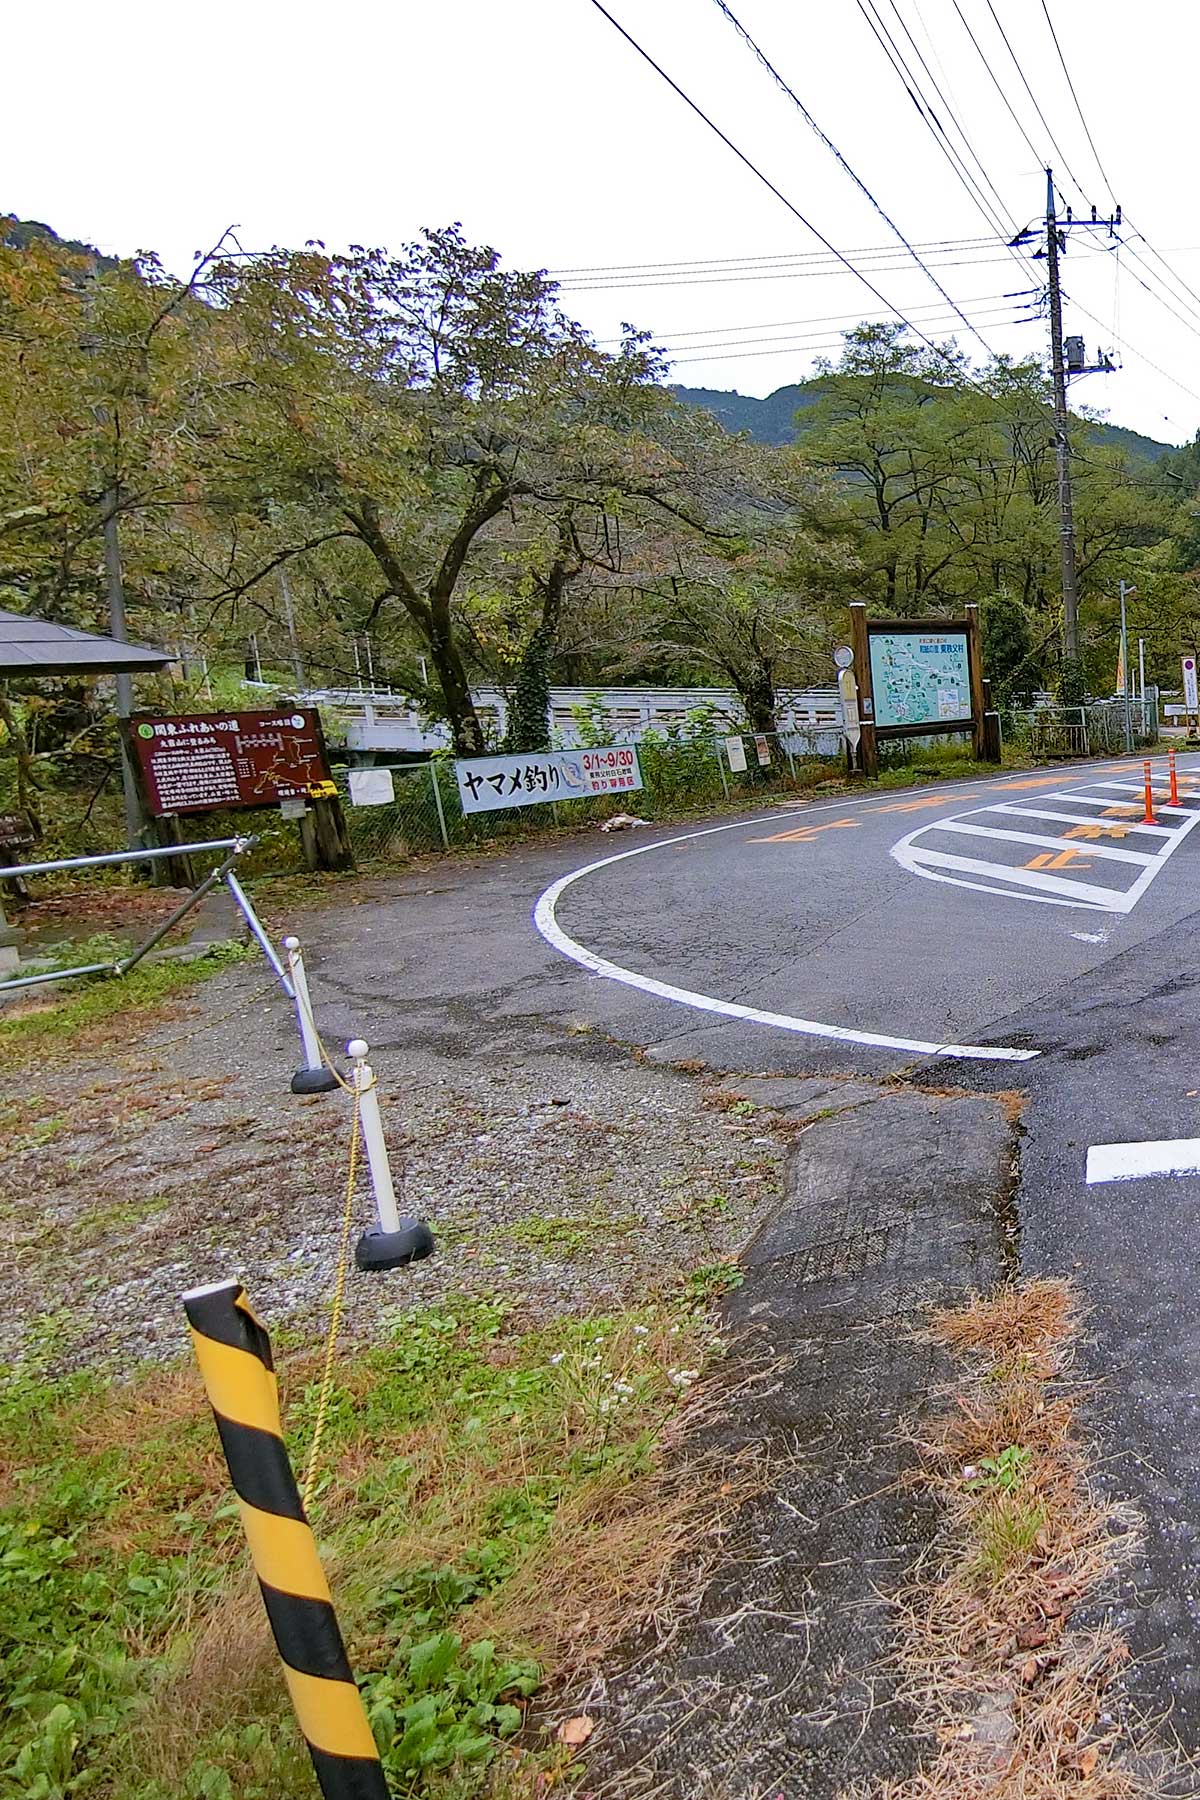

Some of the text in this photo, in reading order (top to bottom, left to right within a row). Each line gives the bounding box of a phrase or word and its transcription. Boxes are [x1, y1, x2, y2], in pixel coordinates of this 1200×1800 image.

[940, 644, 964, 654] 東秩父村
[154, 719, 240, 737] 関東ふれあいの道
[463, 763, 560, 801] ヤマメ釣り
